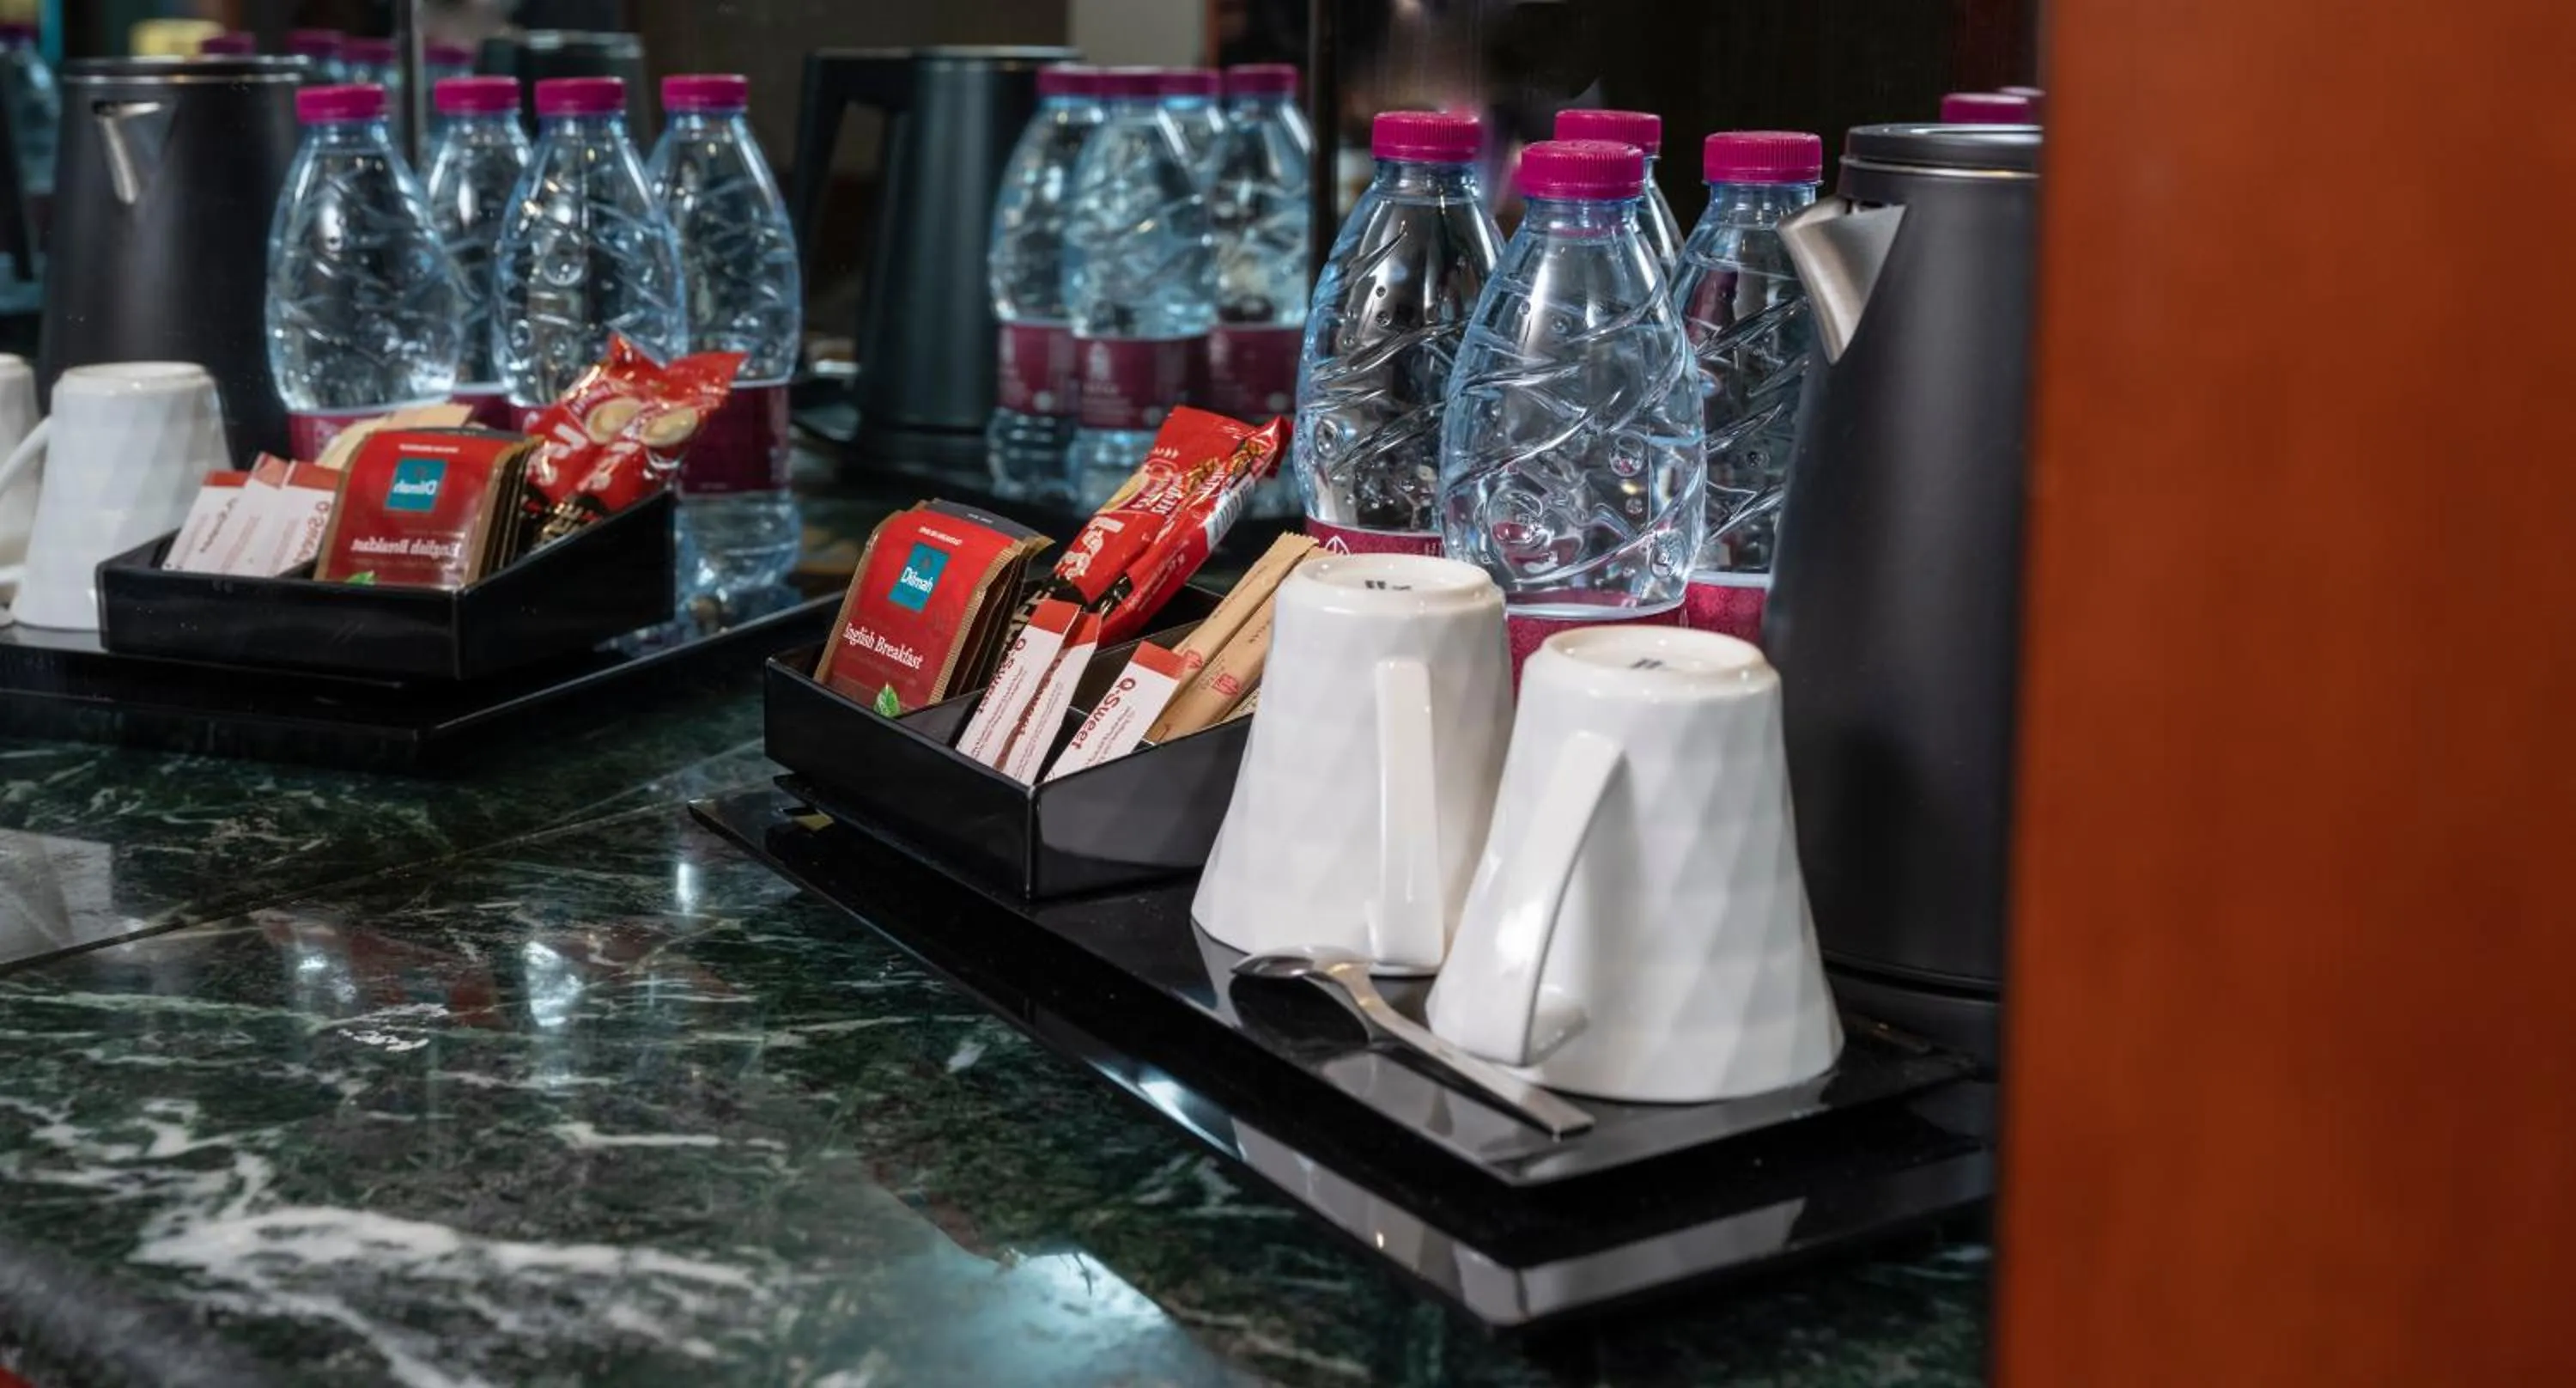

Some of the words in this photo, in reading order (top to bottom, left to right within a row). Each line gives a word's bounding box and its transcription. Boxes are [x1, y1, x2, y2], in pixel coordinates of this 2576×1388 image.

[901, 567, 935, 594] Dilmah
[843, 621, 875, 650] English
[874, 635, 924, 669] Breakfast
[1070, 677, 1136, 750] Q-Sweet
